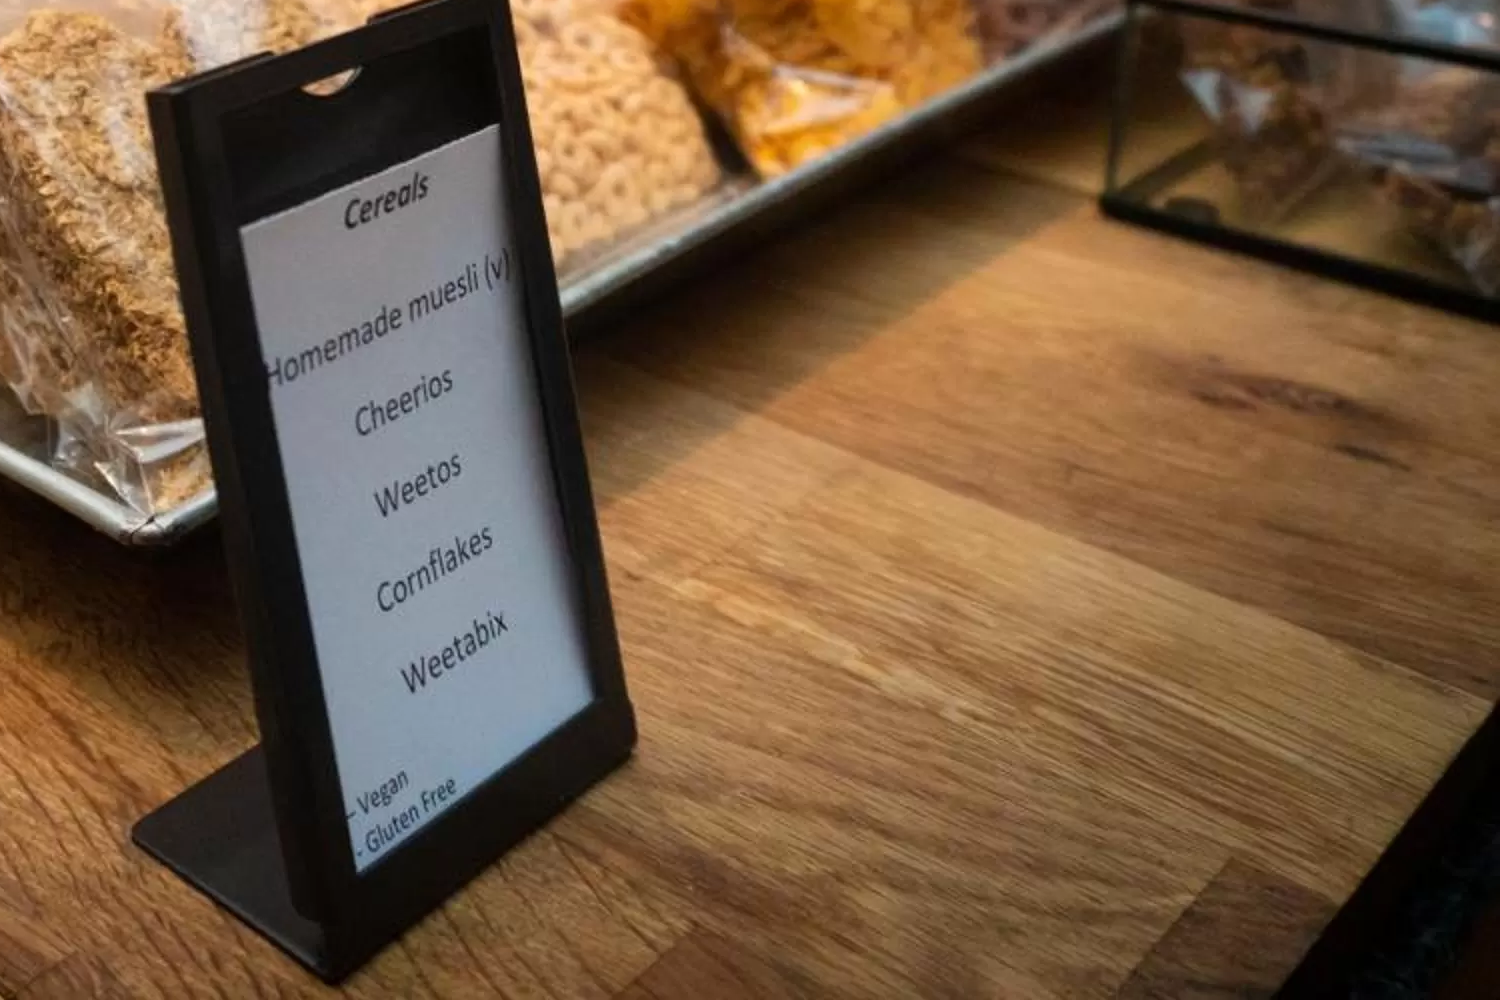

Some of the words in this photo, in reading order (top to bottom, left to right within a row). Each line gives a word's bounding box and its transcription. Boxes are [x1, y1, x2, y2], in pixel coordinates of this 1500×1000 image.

[344, 171, 429, 229] Cereals
[264, 304, 402, 386] Homemade
[409, 263, 479, 322] muesli
[484, 247, 510, 291] (v)
[355, 369, 453, 436] Cheerios
[373, 453, 461, 518] Weetos
[376, 526, 494, 612] Cornflakes
[400, 610, 509, 694] Weetabix
[356, 770, 409, 815] Vegan
[365, 804, 421, 853] Gluten
[420, 778, 457, 813] Free
